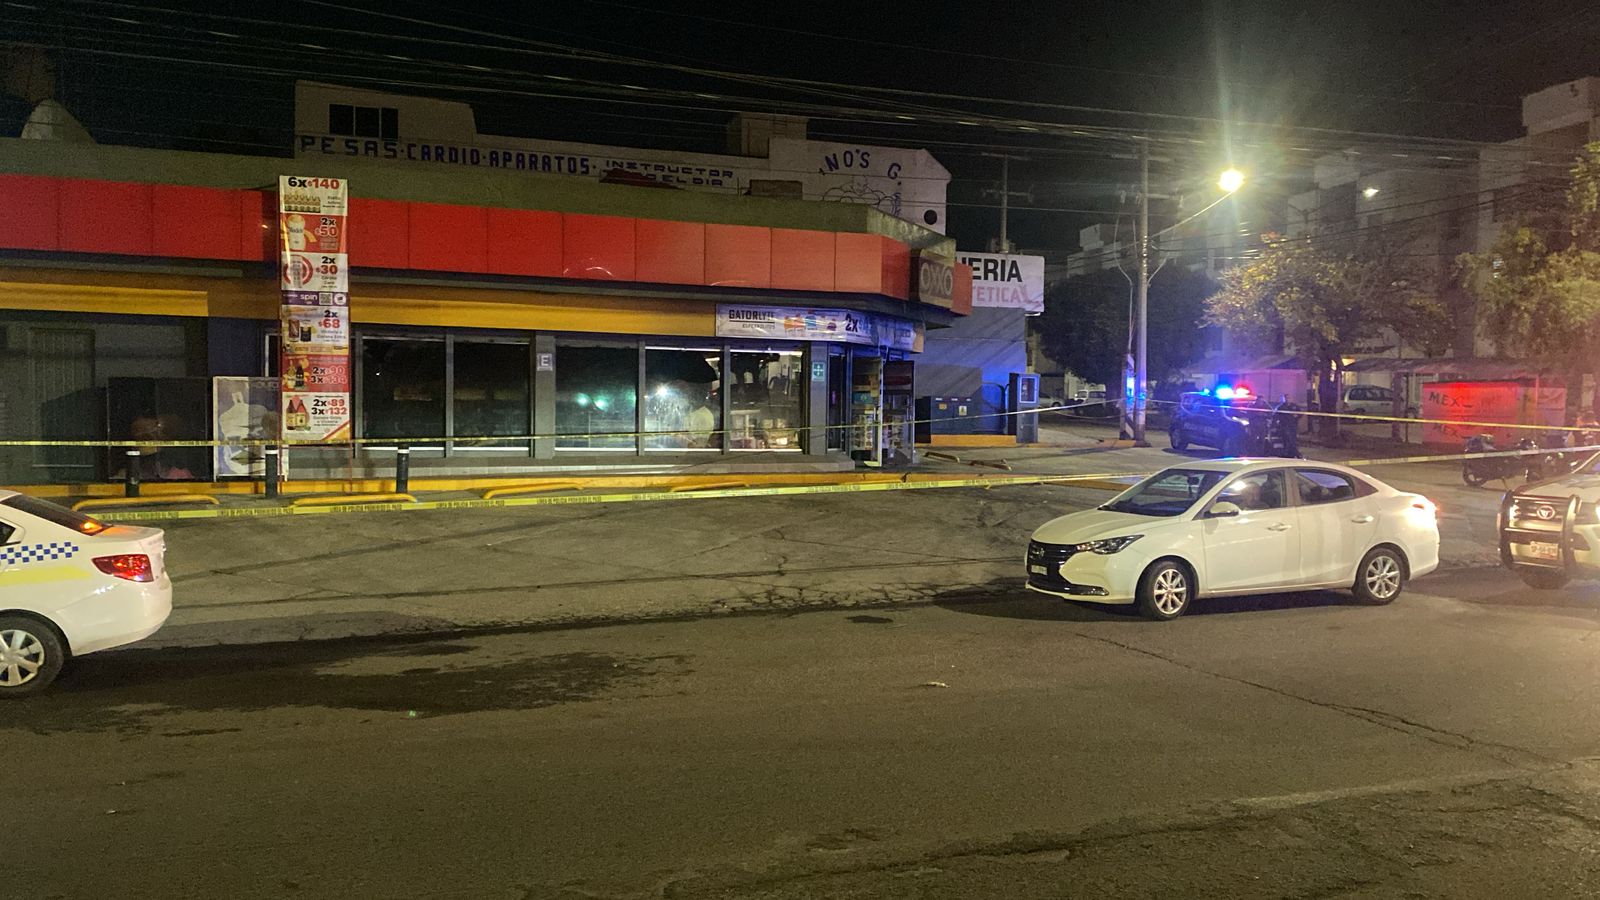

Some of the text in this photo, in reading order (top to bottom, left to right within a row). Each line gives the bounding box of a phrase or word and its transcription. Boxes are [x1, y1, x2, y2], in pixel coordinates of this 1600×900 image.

[301, 135, 590, 175] PESAS CARDIO APARATOS
[321, 256, 336, 264] 2x
[962, 257, 1022, 282] ERIA
[324, 309, 338, 318] 2x
